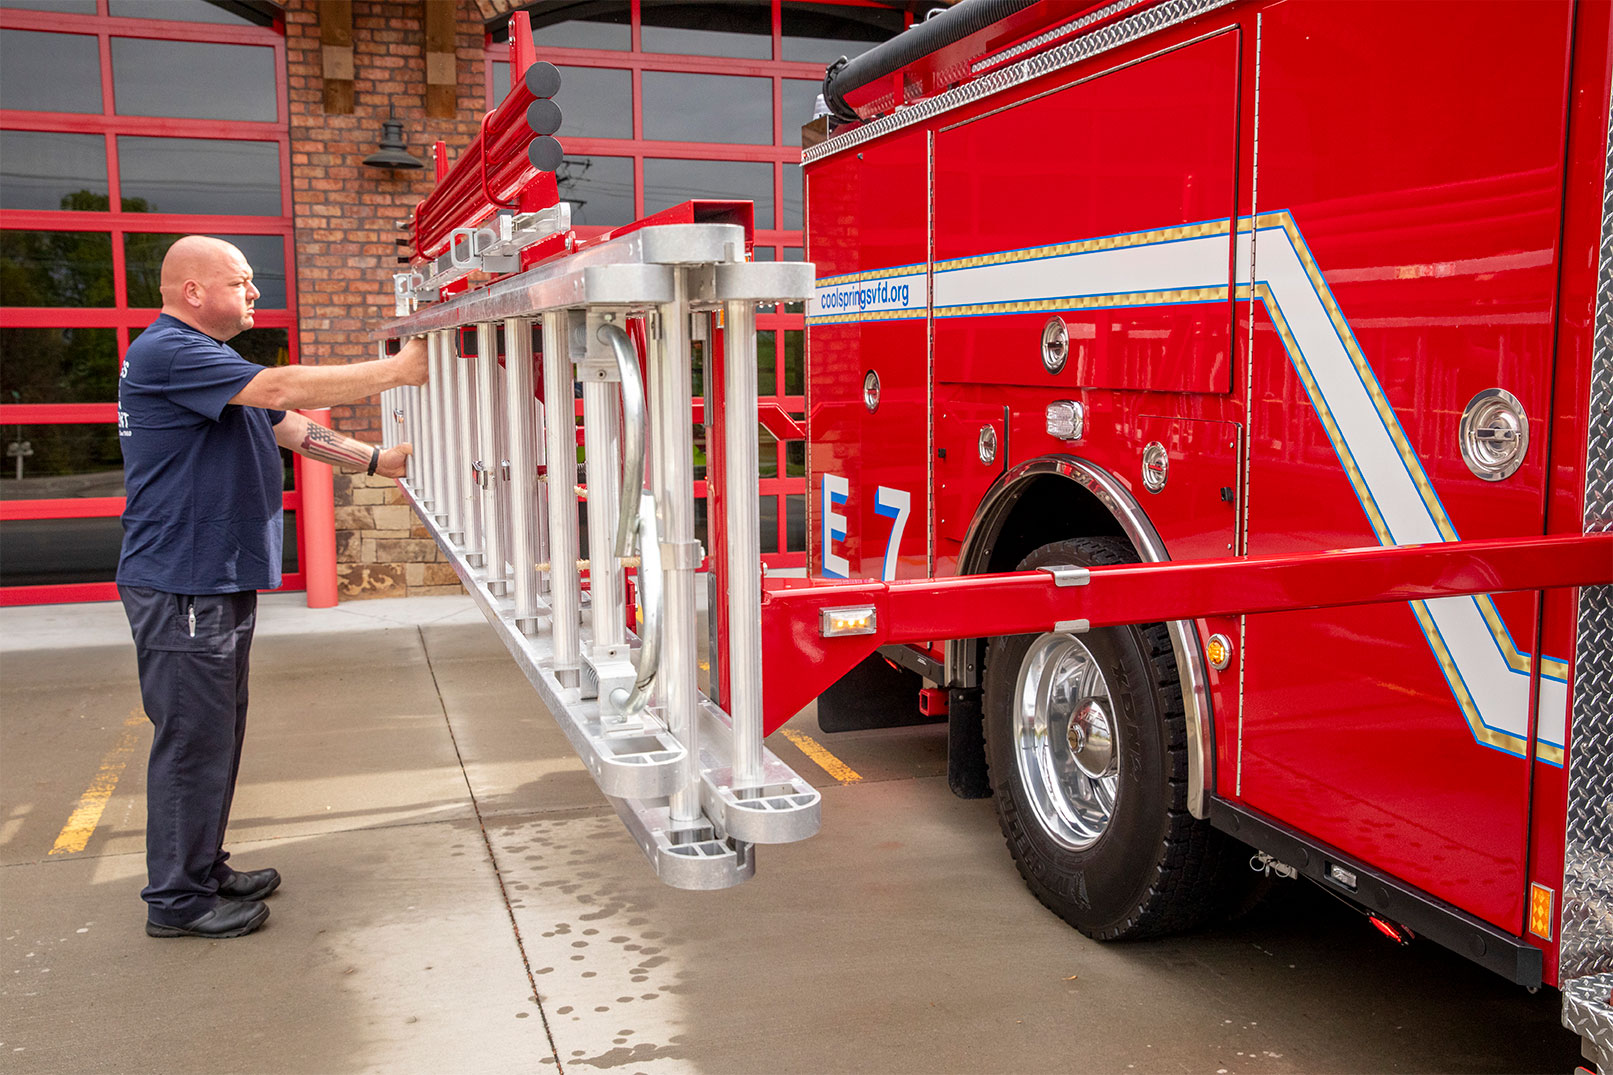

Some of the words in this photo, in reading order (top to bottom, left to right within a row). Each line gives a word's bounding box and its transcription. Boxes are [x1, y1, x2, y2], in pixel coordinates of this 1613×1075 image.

[821, 281, 909, 311] coolspringsvfd.org
[821, 473, 849, 579] E
[874, 485, 911, 581] 7
